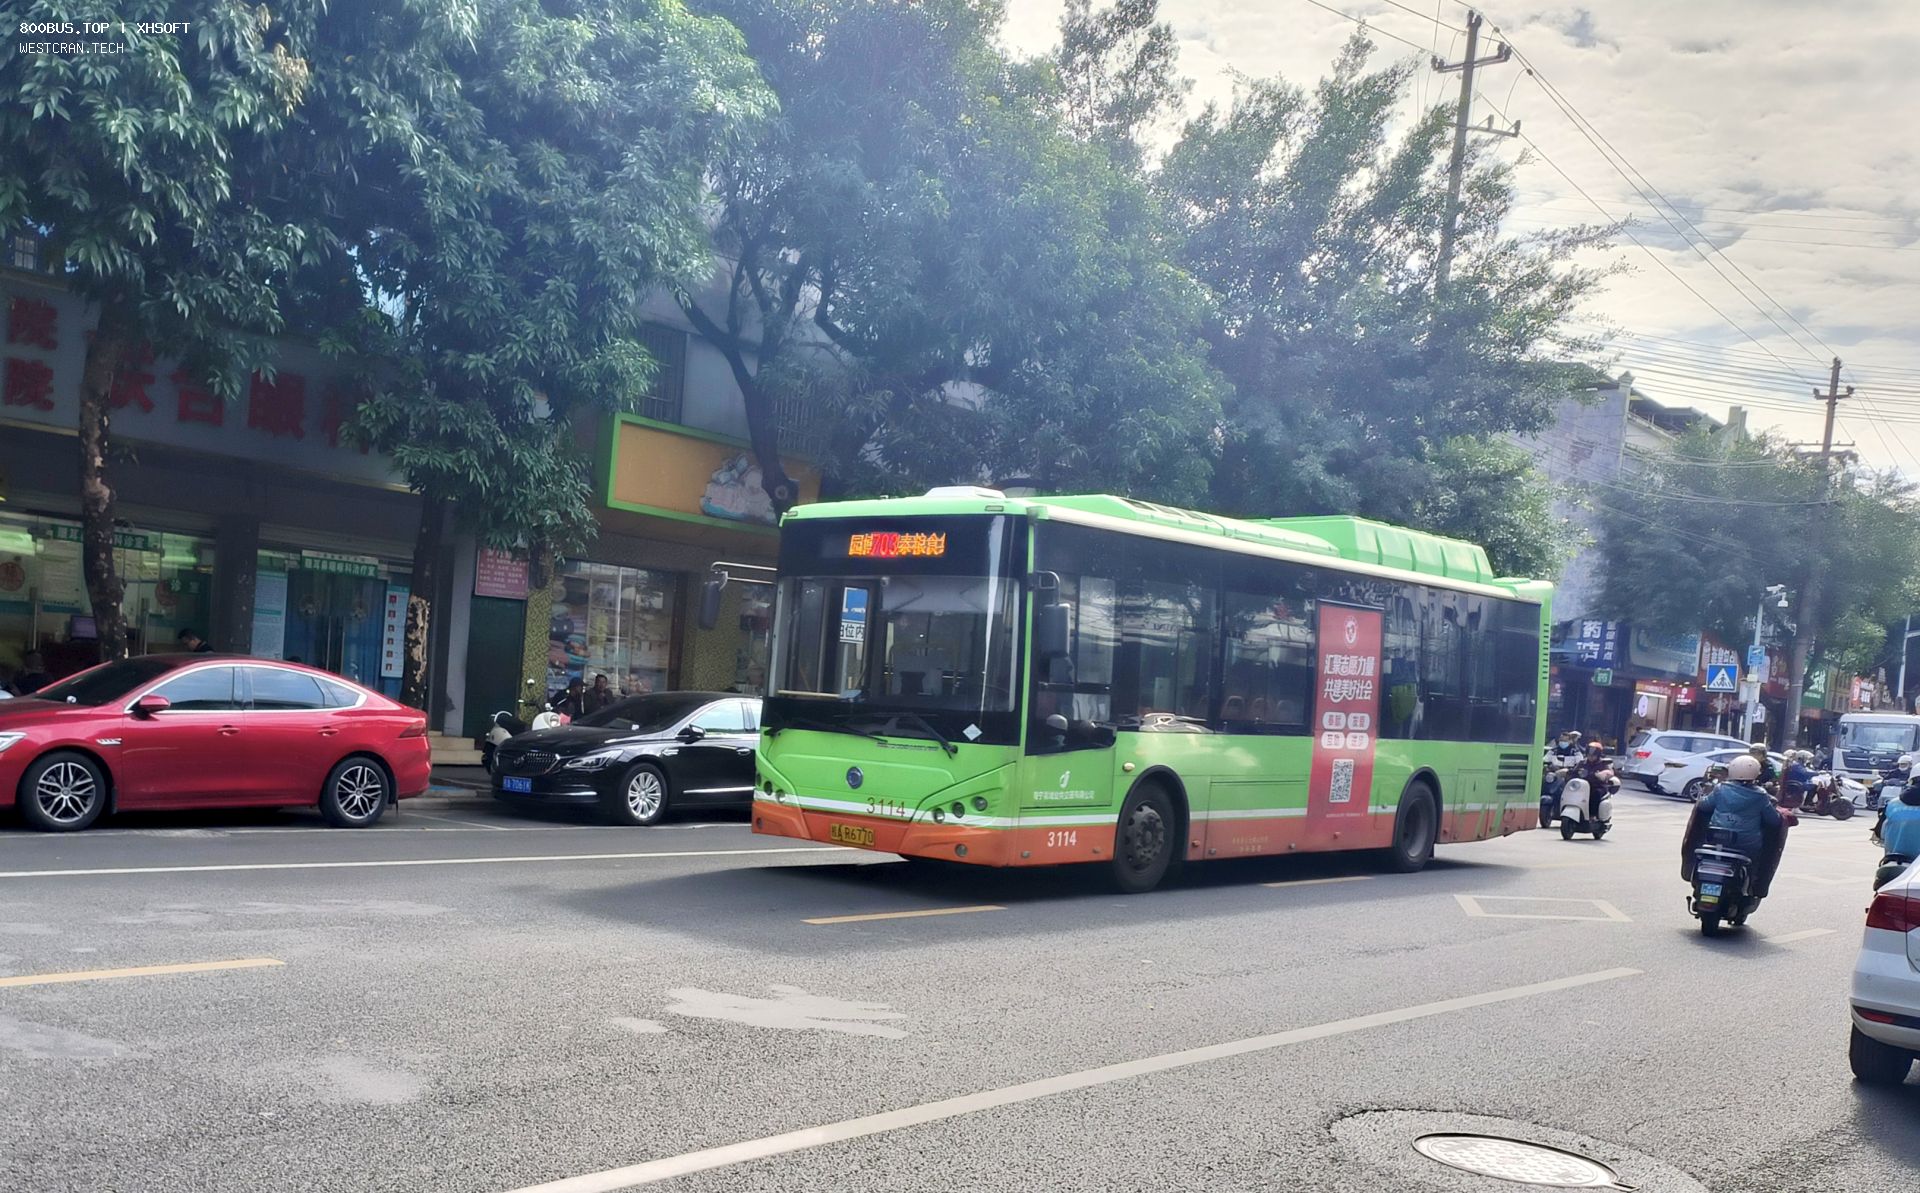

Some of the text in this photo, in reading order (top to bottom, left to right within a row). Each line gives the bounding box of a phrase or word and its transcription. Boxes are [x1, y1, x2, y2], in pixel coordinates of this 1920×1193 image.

[1323, 678, 1373, 703] 共建美好社会
[867, 797, 905, 817] 3114
[1047, 831, 1077, 847] 3114
